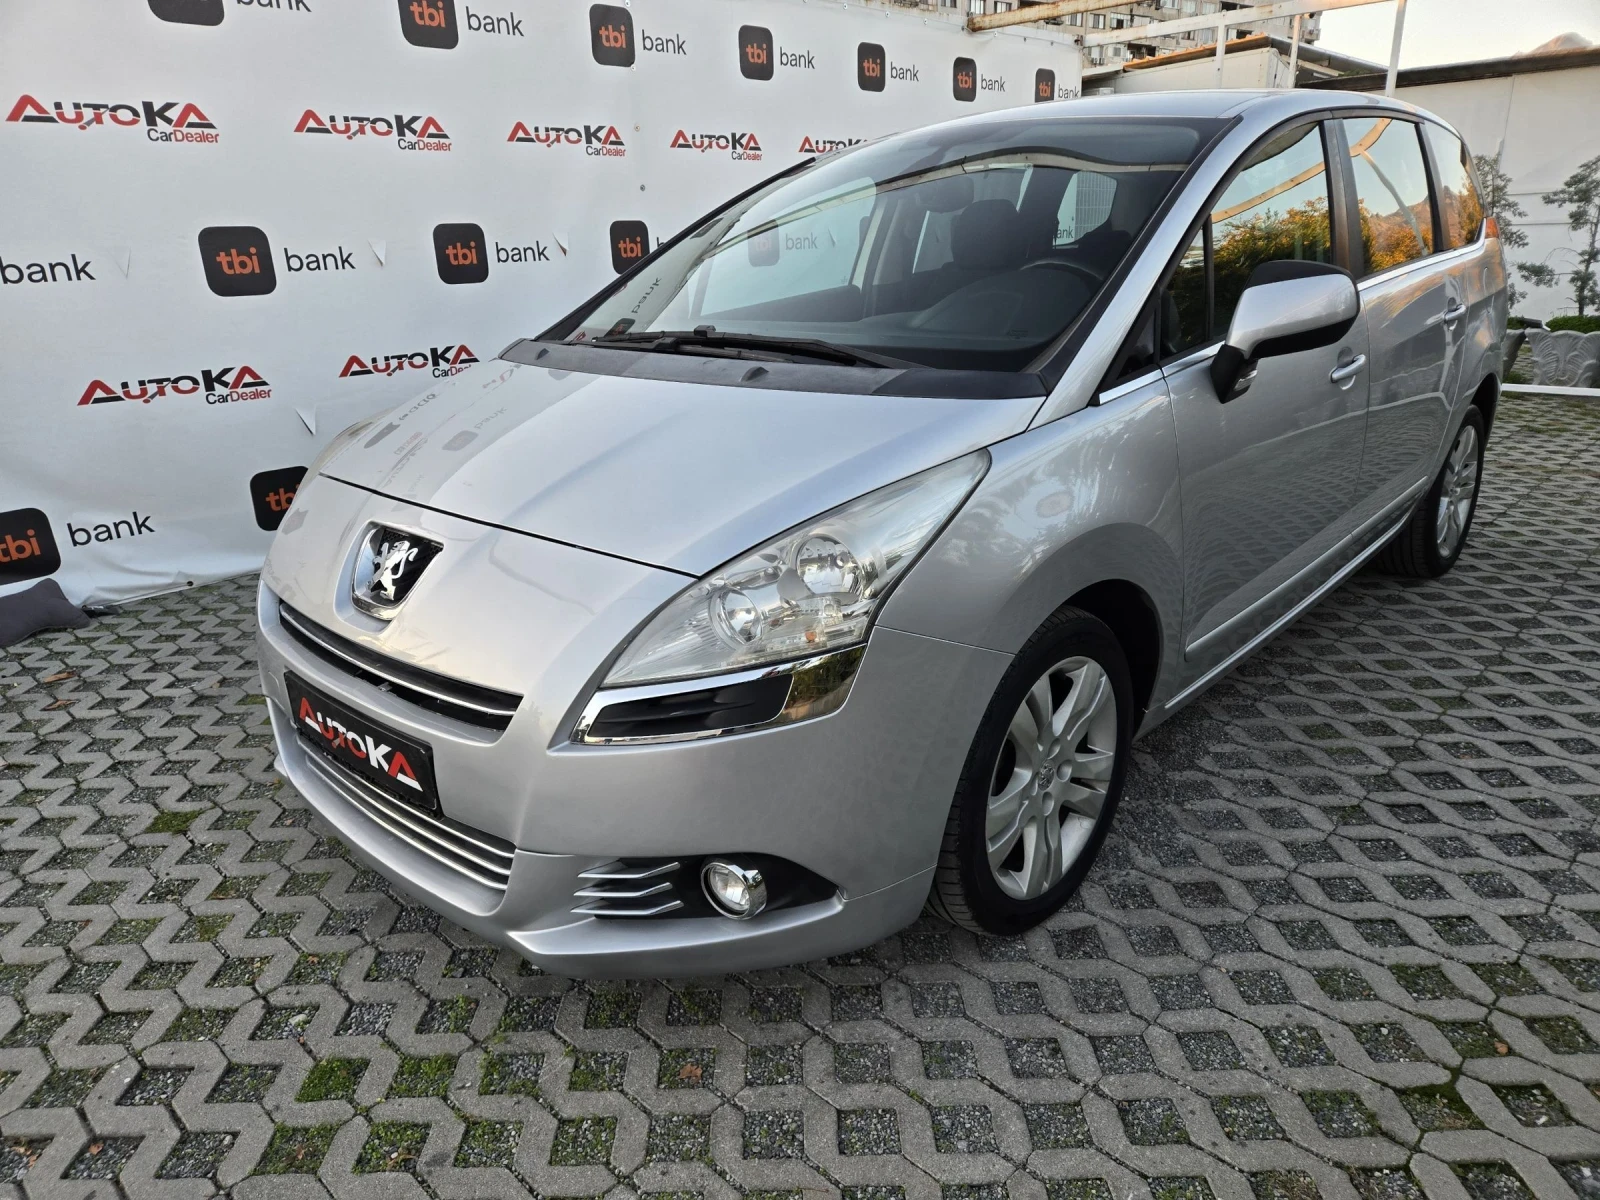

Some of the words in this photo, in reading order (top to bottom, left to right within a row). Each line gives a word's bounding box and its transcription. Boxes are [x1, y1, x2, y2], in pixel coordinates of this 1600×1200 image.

[236, 0, 312, 13] ank
[410, 1, 446, 28] tbi
[465, 6, 525, 37] bank
[599, 24, 627, 49] tbi
[641, 29, 687, 56] bank
[745, 44, 767, 65] tbi
[780, 47, 815, 70] bank
[863, 59, 880, 78] tbi
[890, 64, 919, 82] bank
[957, 71, 972, 90] tbi
[981, 76, 1006, 92] bank
[1039, 82, 1051, 97] tbi
[1058, 84, 1080, 99] bank
[6, 94, 217, 130] AUTOKA
[147, 127, 220, 144] CarDealer
[294, 109, 451, 140] AUTOKA
[507, 121, 625, 147] AUTOKA
[398, 138, 452, 152] CarDealer
[585, 145, 626, 157] CarDealer
[670, 129, 761, 153] AUTOKA
[798, 136, 868, 153] AUTOK
[731, 151, 763, 161] CarDealer
[785, 232, 819, 251] bank
[1056, 226, 1074, 239] ank
[445, 241, 478, 266] tbi
[495, 241, 550, 264] bank
[618, 236, 642, 258] tbi
[0, 253, 96, 285] bank
[216, 246, 260, 275] tbi
[283, 246, 356, 273] bank
[338, 344, 480, 378] AUTOKA
[76, 365, 271, 406] AUTOKA
[205, 387, 272, 405] CarDealer
[265, 483, 301, 512] tb
[66, 511, 155, 547] bank
[299, 697, 424, 792] AUTOKA
